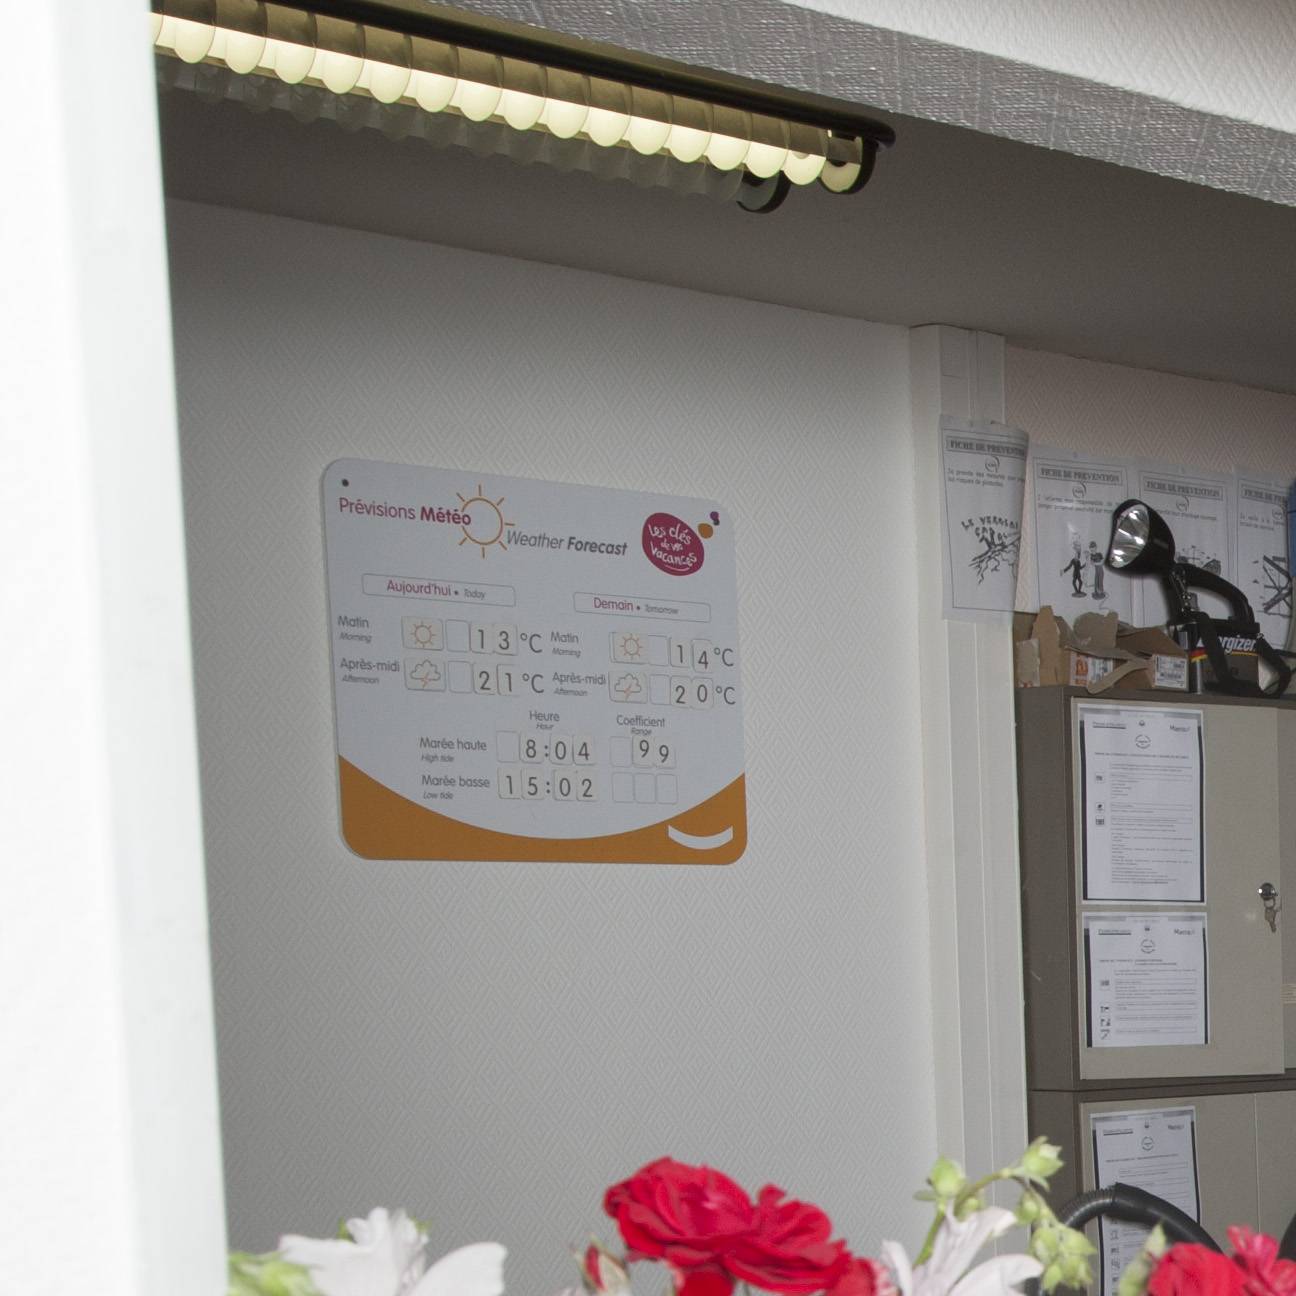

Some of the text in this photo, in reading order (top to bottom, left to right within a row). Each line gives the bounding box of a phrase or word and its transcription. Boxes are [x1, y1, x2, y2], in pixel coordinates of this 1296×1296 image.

[950, 440, 985, 451] FICHE DE
[1040, 468, 1073, 479] FICHE DE
[1146, 481, 1177, 492] FICHE DE
[339, 497, 471, 526] Prévisions Météo
[506, 530, 628, 556] Weather Forecast
[386, 579, 486, 600] Aujourd'hui Today
[593, 596, 679, 615] Demain Tomorrow
[337, 615, 372, 644] Matin Morning
[550, 631, 581, 659] Matin Morning
[340, 657, 400, 685] Après-midi Afternoon
[552, 671, 606, 697] Après-midi Afternoon
[529, 709, 560, 722] Heure
[616, 714, 666, 728] Coefficient
[536, 722, 554, 731] Hour
[631, 727, 652, 737] Range
[419, 737, 487, 751] Marée haute
[421, 754, 455, 764] High tide
[421, 774, 490, 788] Marée basse
[423, 791, 454, 800] Low tide
